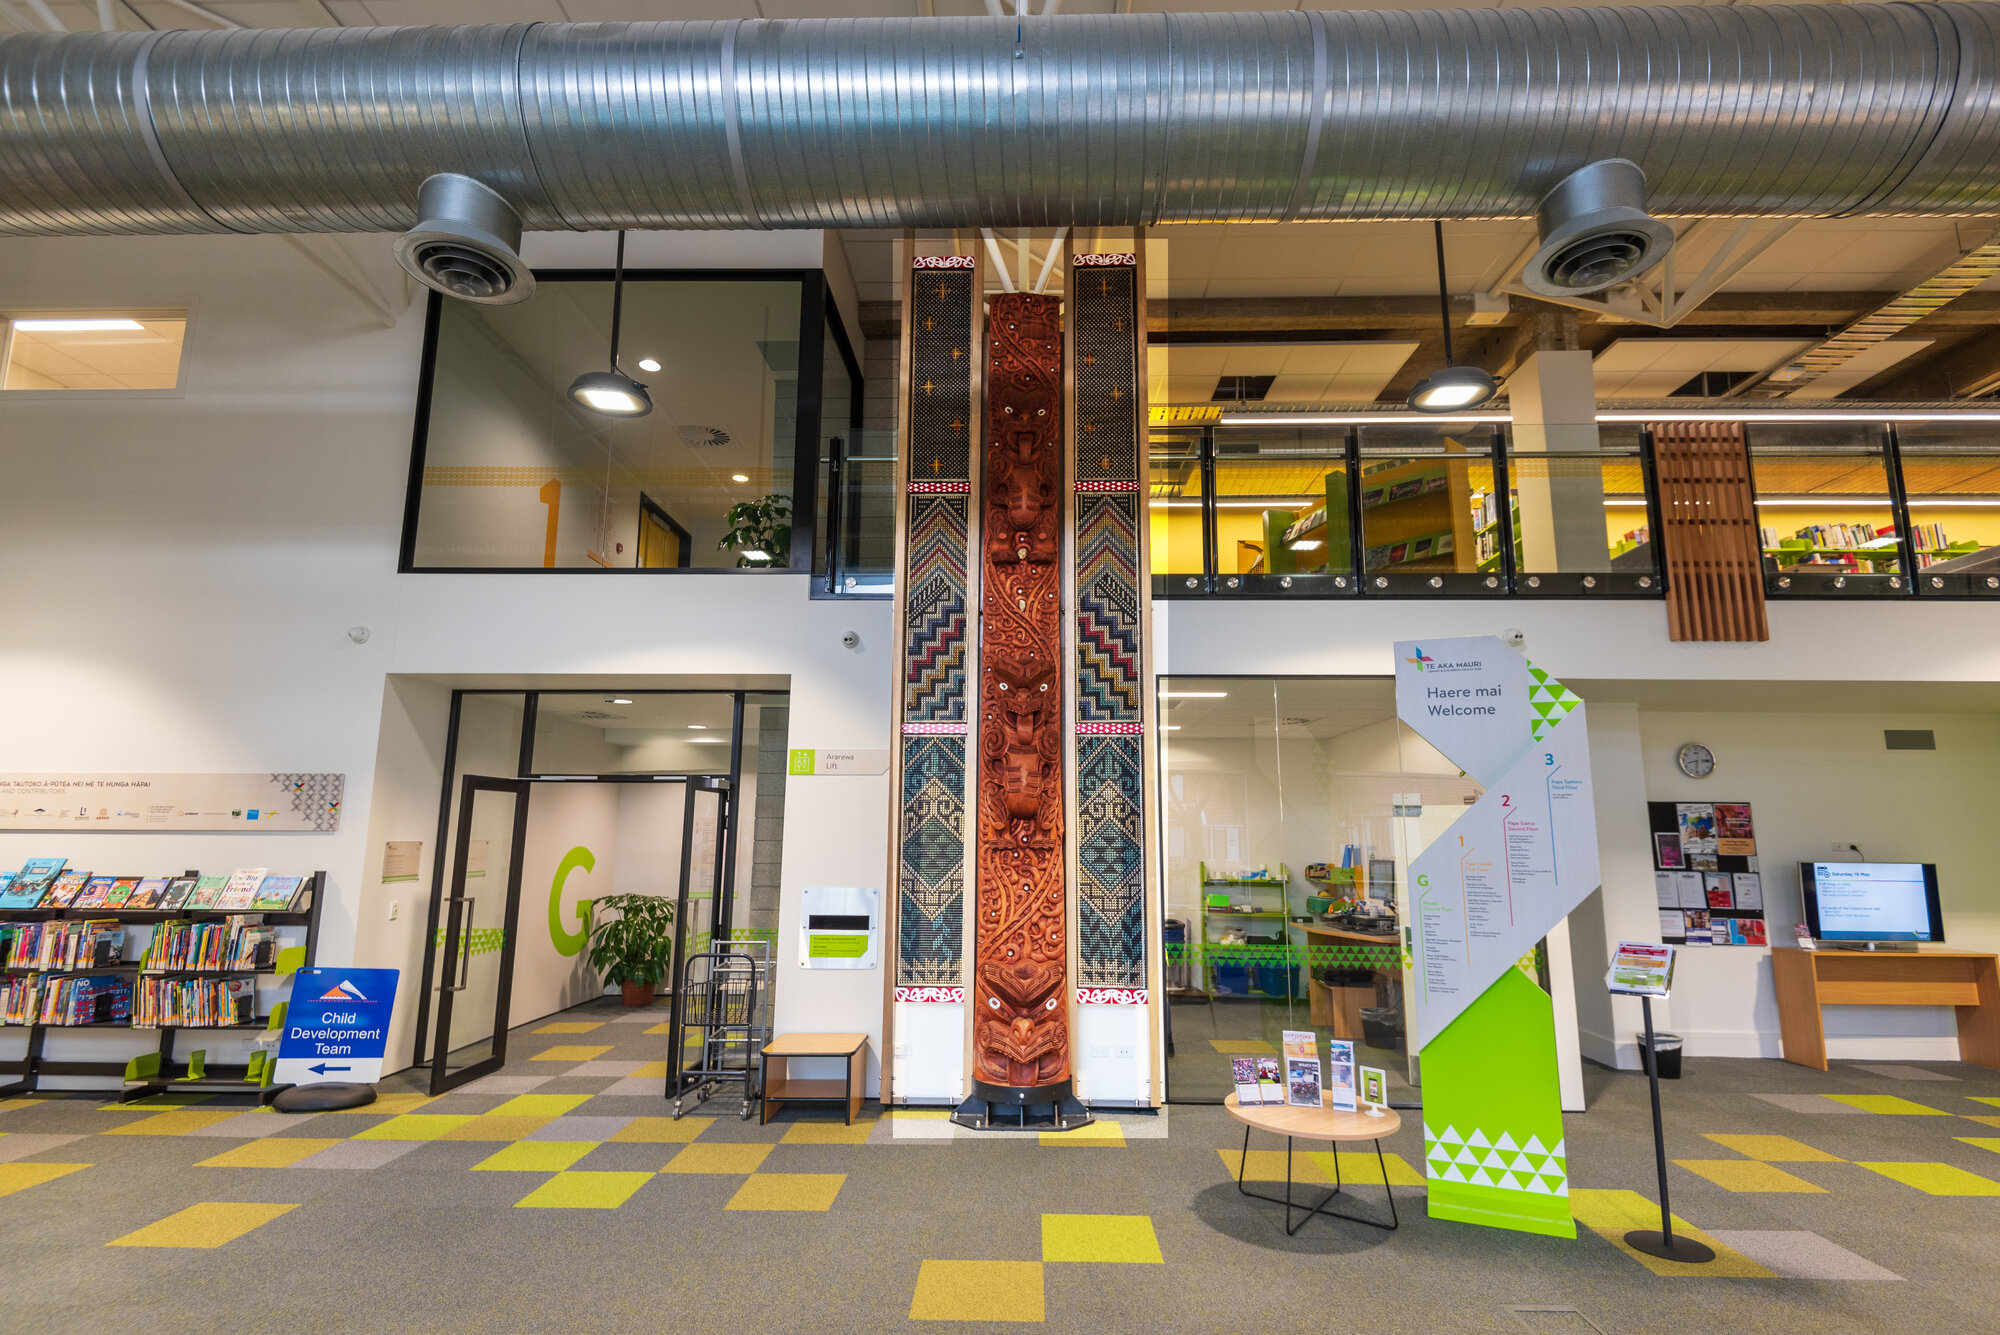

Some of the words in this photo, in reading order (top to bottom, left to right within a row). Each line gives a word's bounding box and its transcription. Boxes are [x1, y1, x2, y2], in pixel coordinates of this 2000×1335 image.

[1427, 686, 1471, 698] Haere
[1476, 685, 1502, 697] mai
[1428, 704, 1496, 716] Welcome
[1544, 753, 1555, 766] 3
[1501, 794, 1511, 807] 2
[1458, 835, 1464, 847] 1
[1417, 874, 1429, 887] G
[548, 846, 596, 957] G
[321, 1012, 356, 1024] Child
[290, 1027, 380, 1041] Development
[315, 1042, 351, 1055] Team
